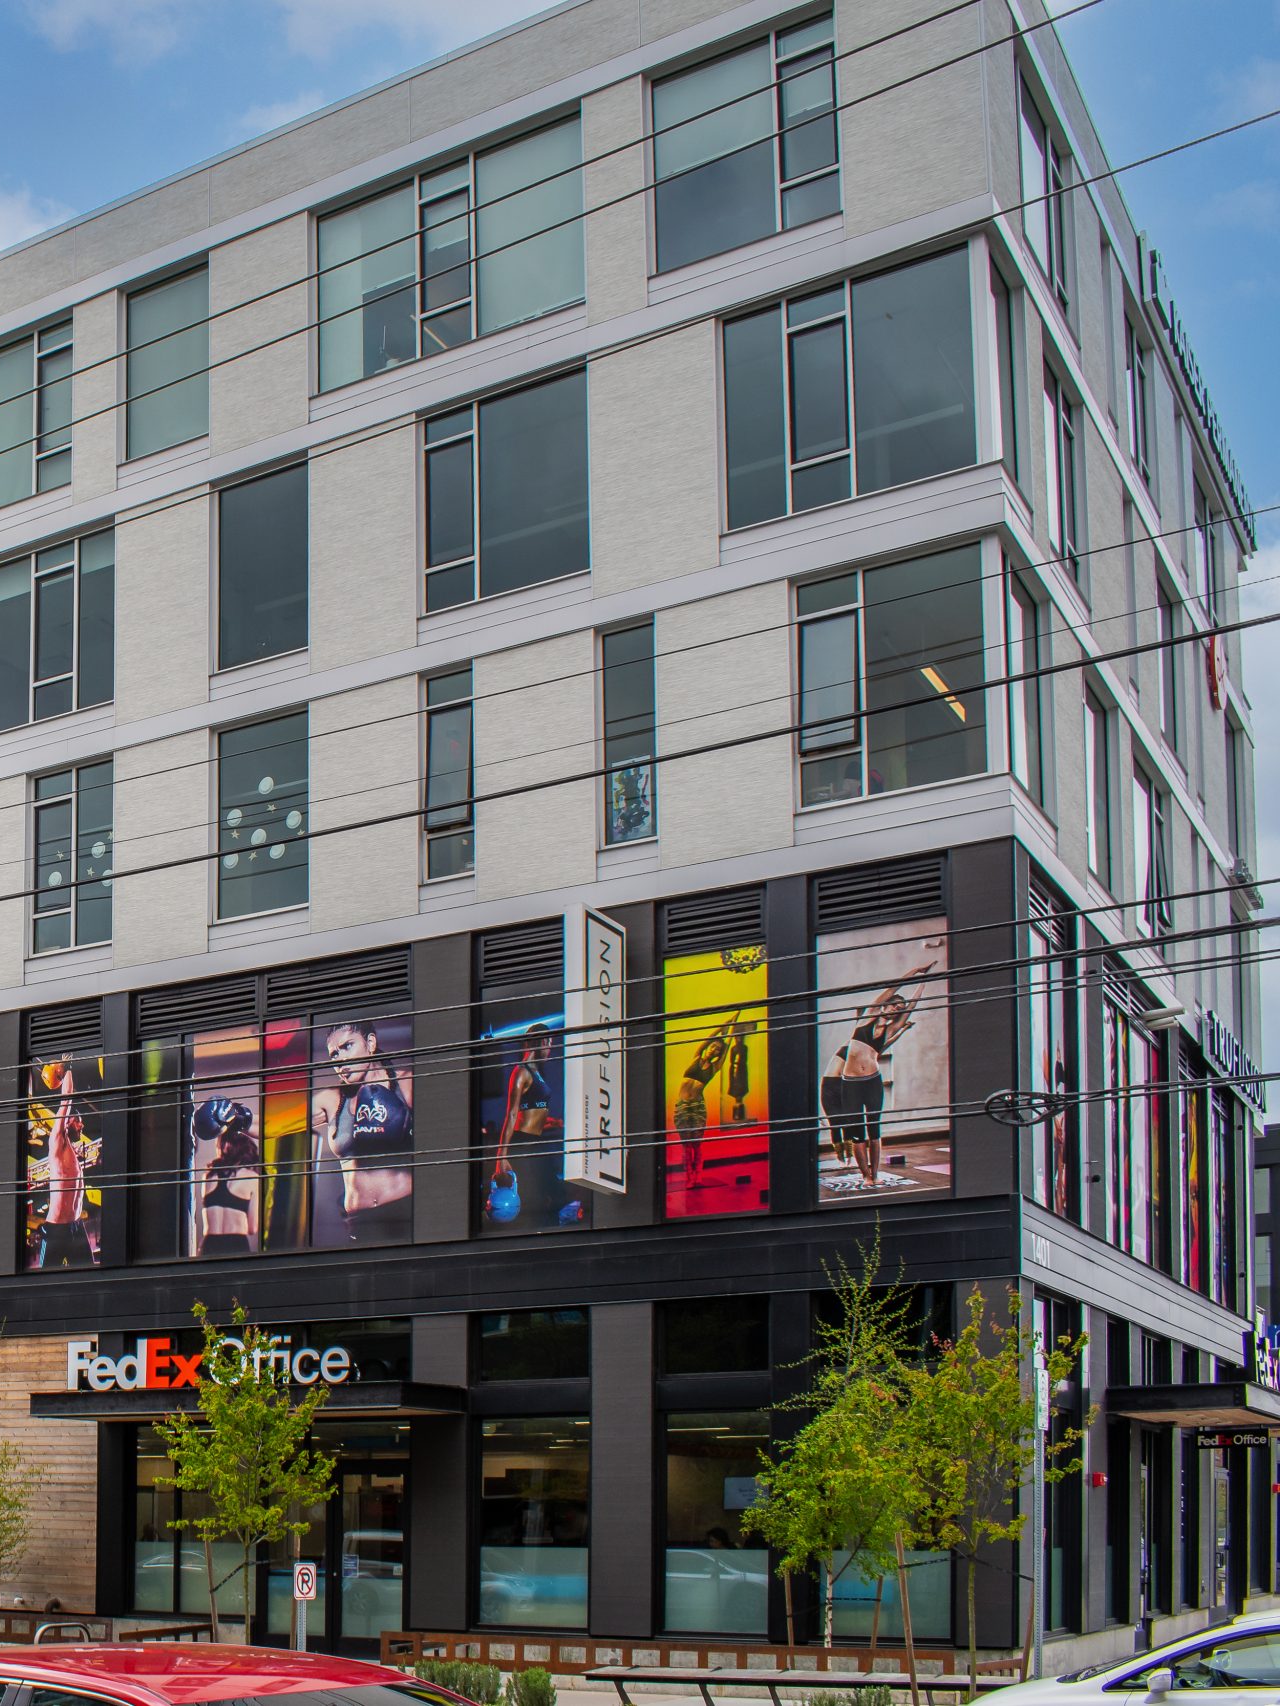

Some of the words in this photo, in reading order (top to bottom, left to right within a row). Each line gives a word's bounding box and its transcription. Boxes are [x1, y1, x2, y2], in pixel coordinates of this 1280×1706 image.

[598, 938, 611, 1161] TRUFUSION
[1031, 1231, 1050, 1268] 1401
[67, 1337, 204, 1391] FedEx
[210, 1335, 350, 1385] Office
[1198, 1434, 1233, 1446] FedEx
[1233, 1434, 1267, 1445] Office
